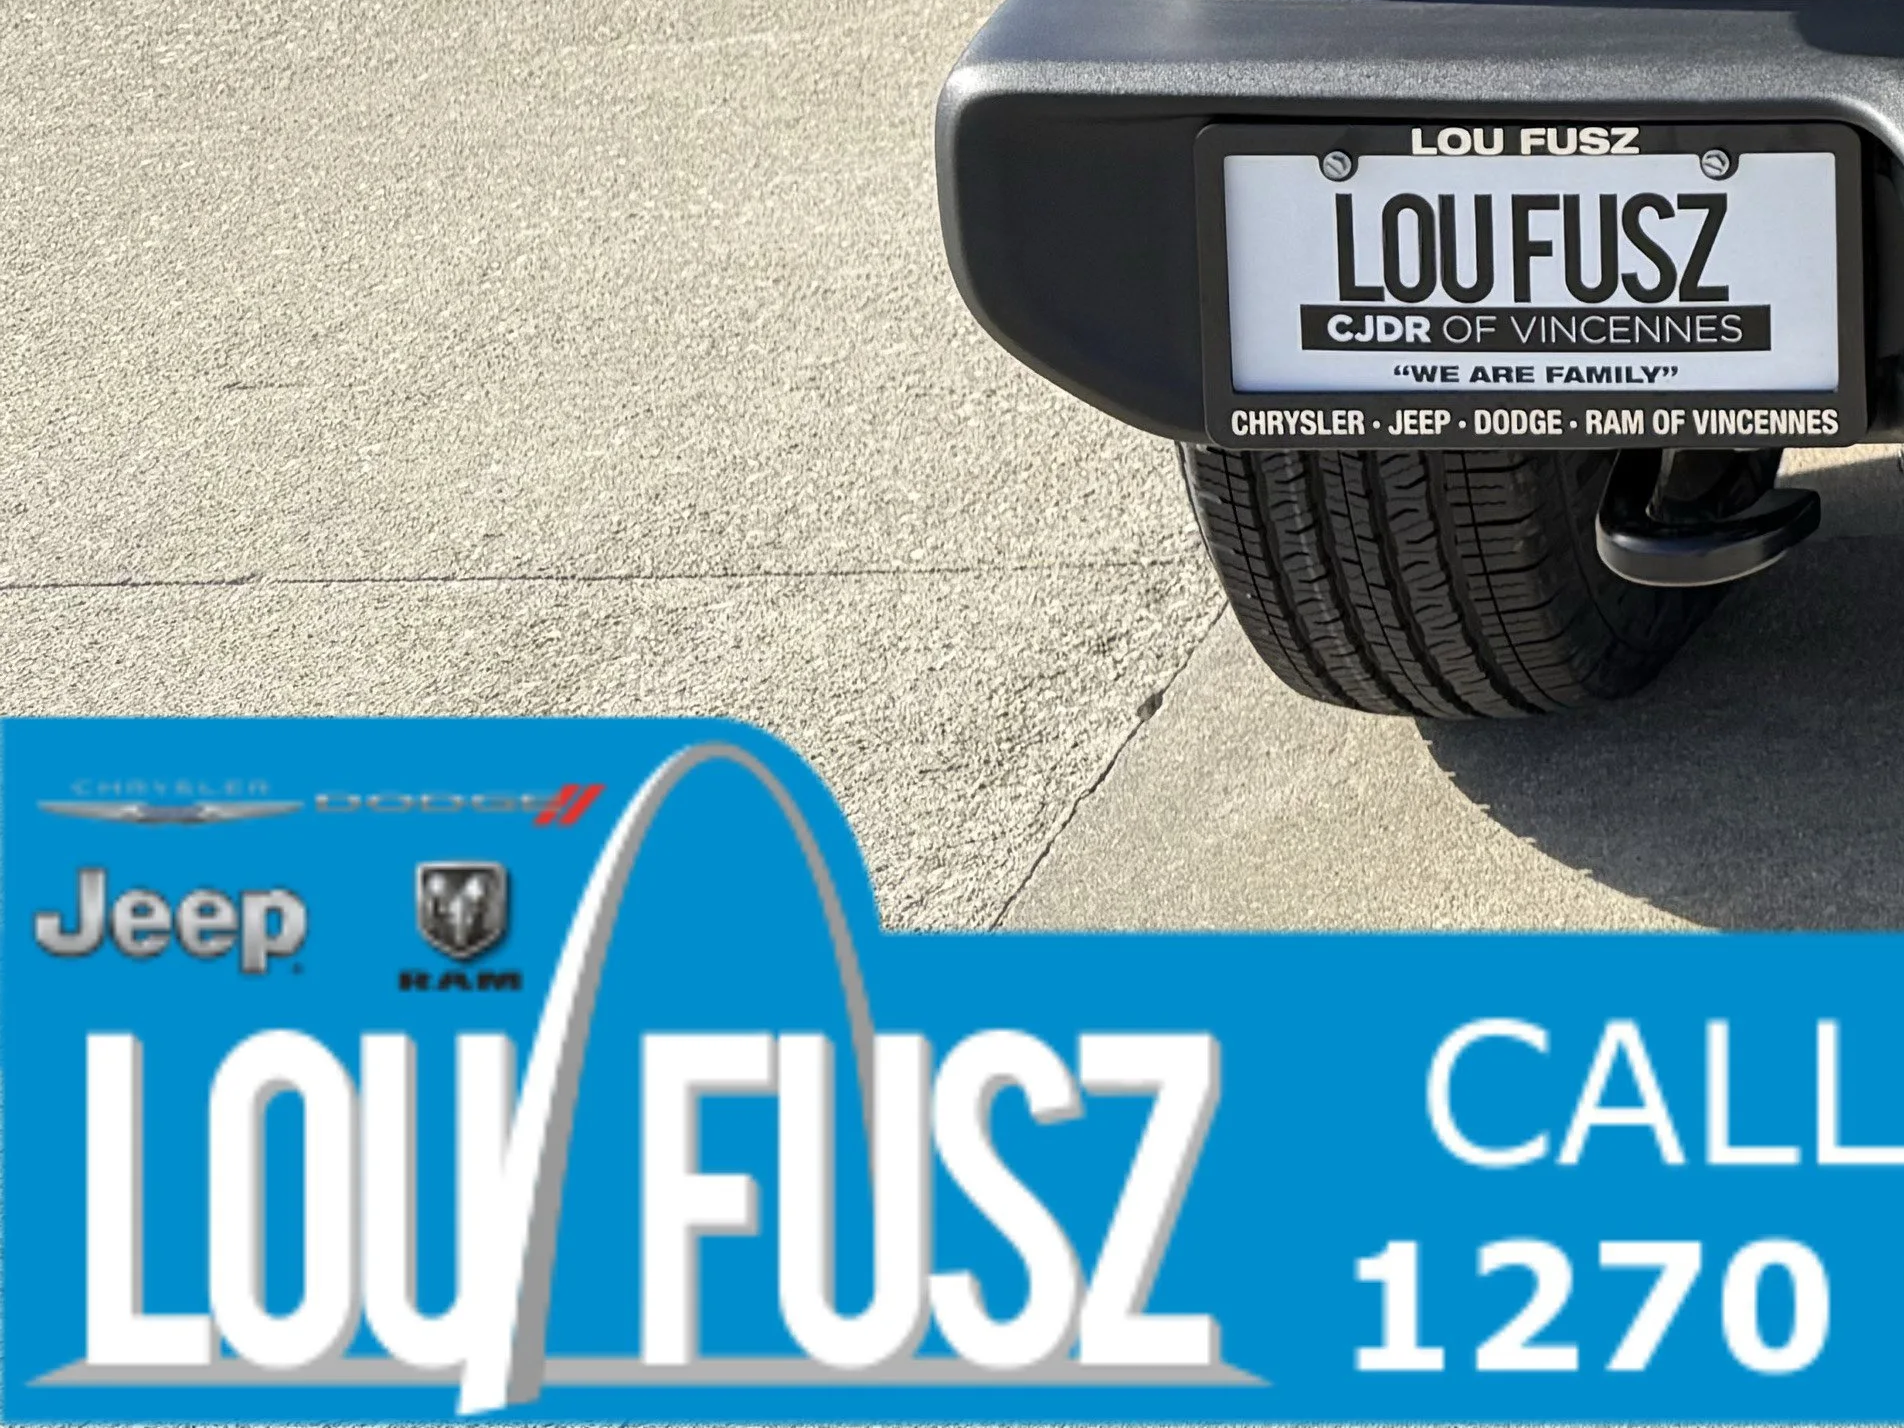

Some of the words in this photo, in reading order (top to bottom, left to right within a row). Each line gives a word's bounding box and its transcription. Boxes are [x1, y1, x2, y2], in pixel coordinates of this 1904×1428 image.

[1407, 127, 1508, 158] LOU
[1516, 126, 1643, 158] FUSZ
[1335, 192, 1495, 304] LOU
[1511, 192, 1730, 304] FUSZ
[1327, 313, 1431, 343] CJDR
[1442, 315, 1497, 344] OF
[1510, 314, 1743, 344] VINCENNES
[1393, 365, 1460, 383] “WE
[1469, 365, 1535, 384] ARE
[1545, 365, 1679, 384] FAMILY”
[1231, 409, 1366, 436] CHRYSLER
[1387, 409, 1451, 436] JEEP
[1474, 409, 1563, 435] DODGE
[1585, 409, 1645, 435] RAM
[1652, 409, 1686, 435] OF
[1692, 408, 1839, 435] VINCENNES
